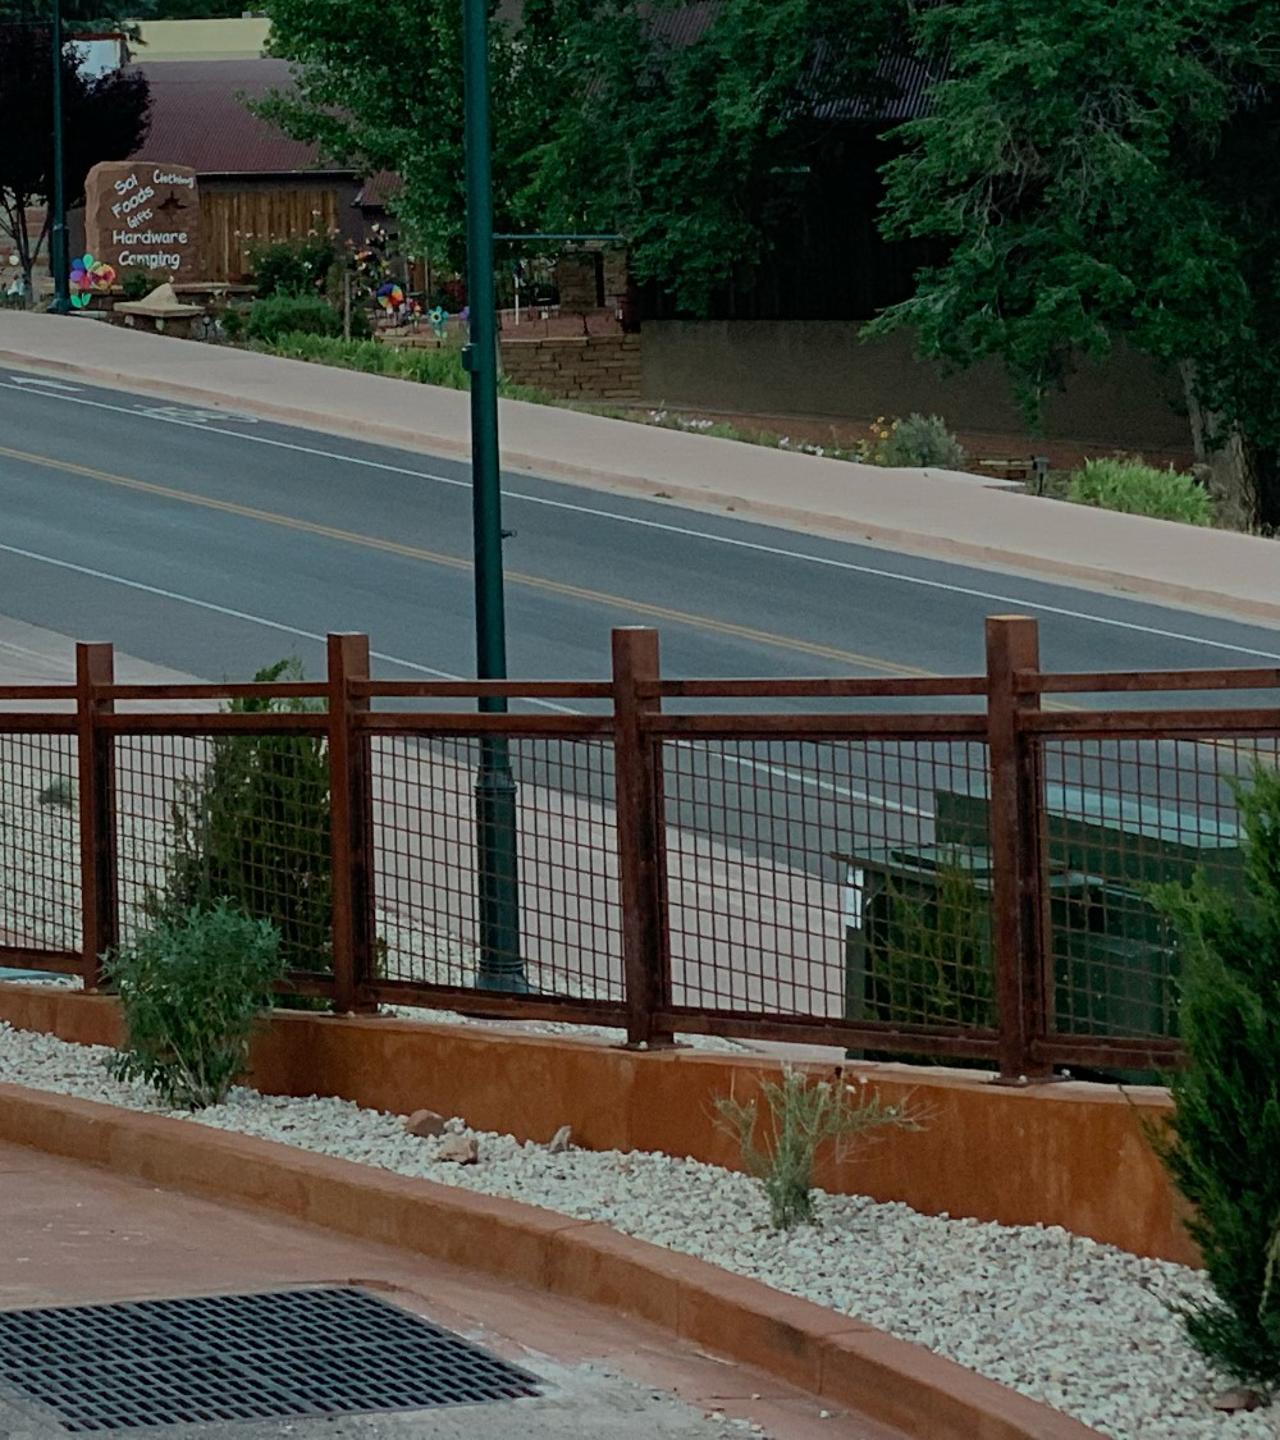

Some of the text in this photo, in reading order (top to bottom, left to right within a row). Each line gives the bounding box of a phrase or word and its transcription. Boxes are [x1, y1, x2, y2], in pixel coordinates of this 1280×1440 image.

[114, 173, 138, 195] Sol
[111, 186, 155, 218] Foods
[113, 229, 188, 244] Hardware
[119, 251, 180, 270] Camping
